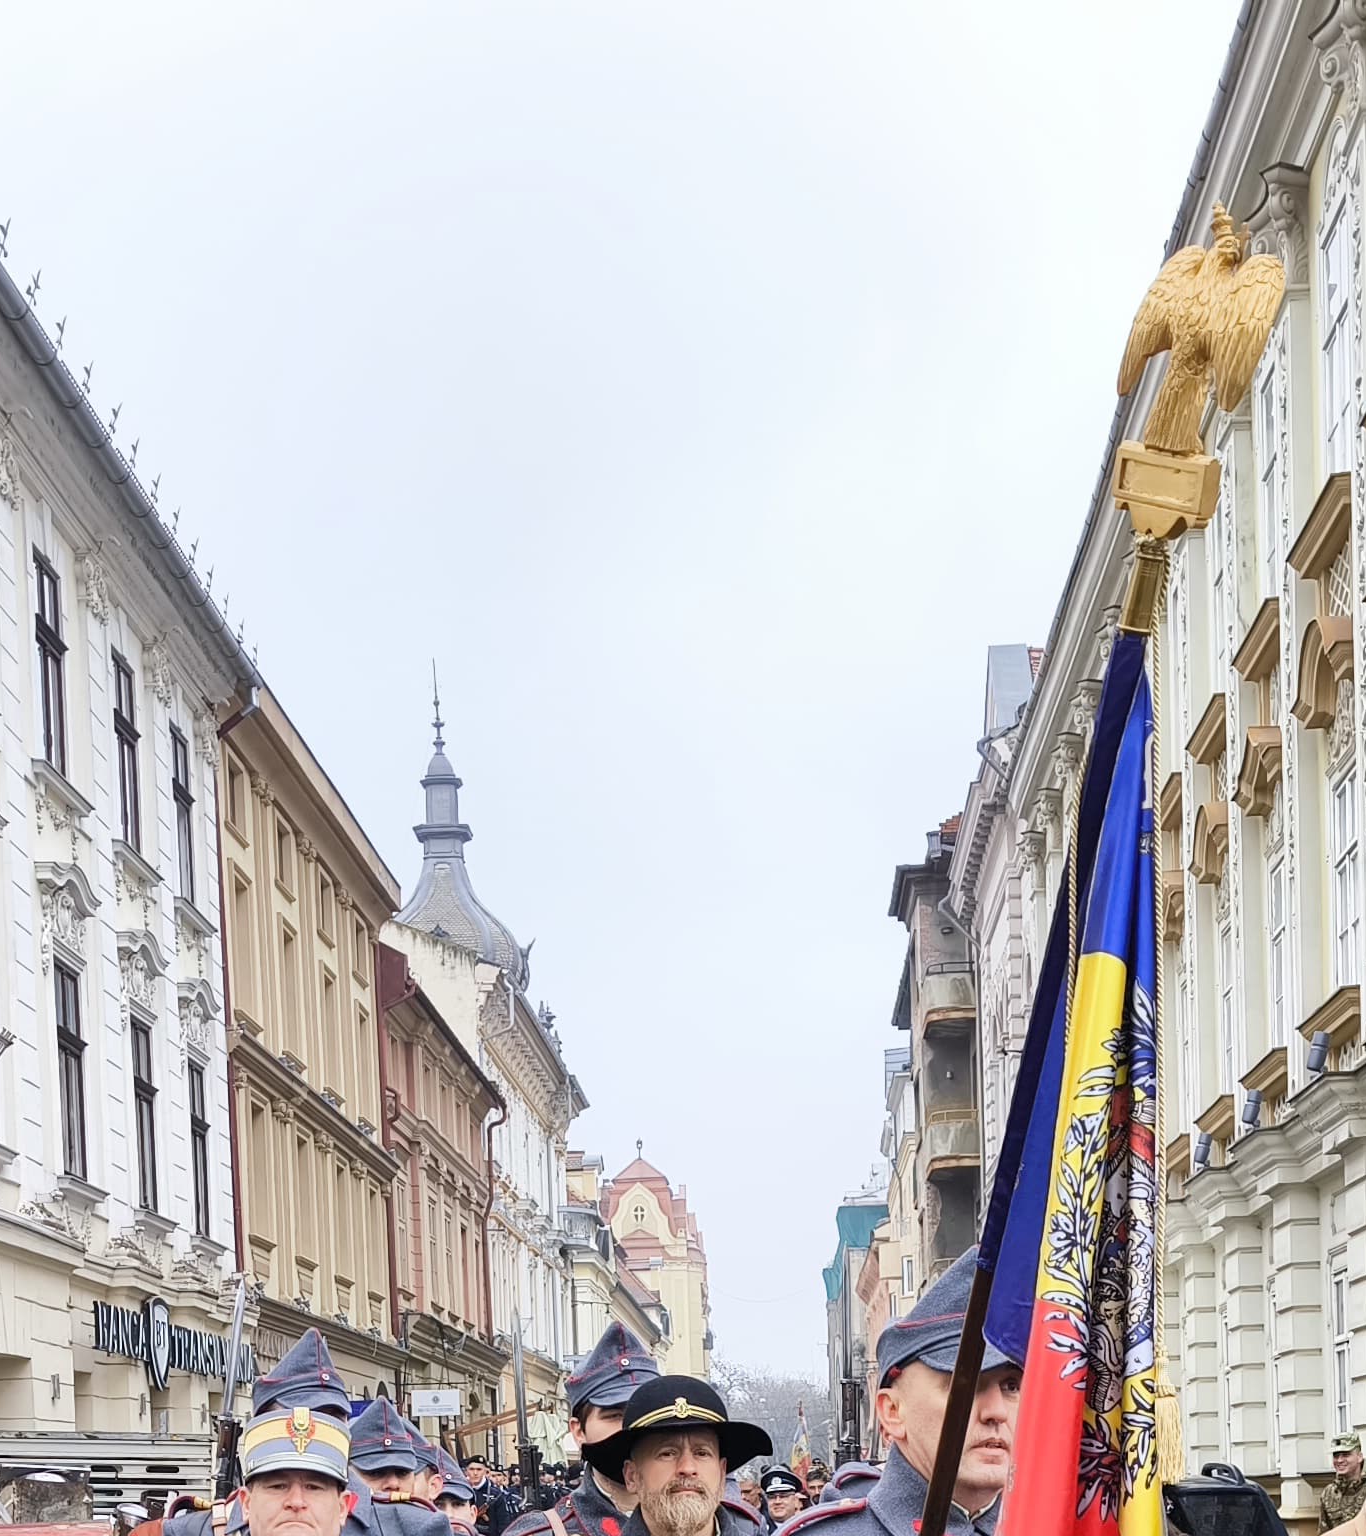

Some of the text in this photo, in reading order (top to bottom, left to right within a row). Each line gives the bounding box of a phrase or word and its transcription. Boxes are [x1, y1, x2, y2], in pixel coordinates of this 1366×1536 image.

[94, 1299, 150, 1362] BANCA
[170, 1324, 256, 1385] TRANSILVNIA
[155, 1319, 167, 1350] BT
